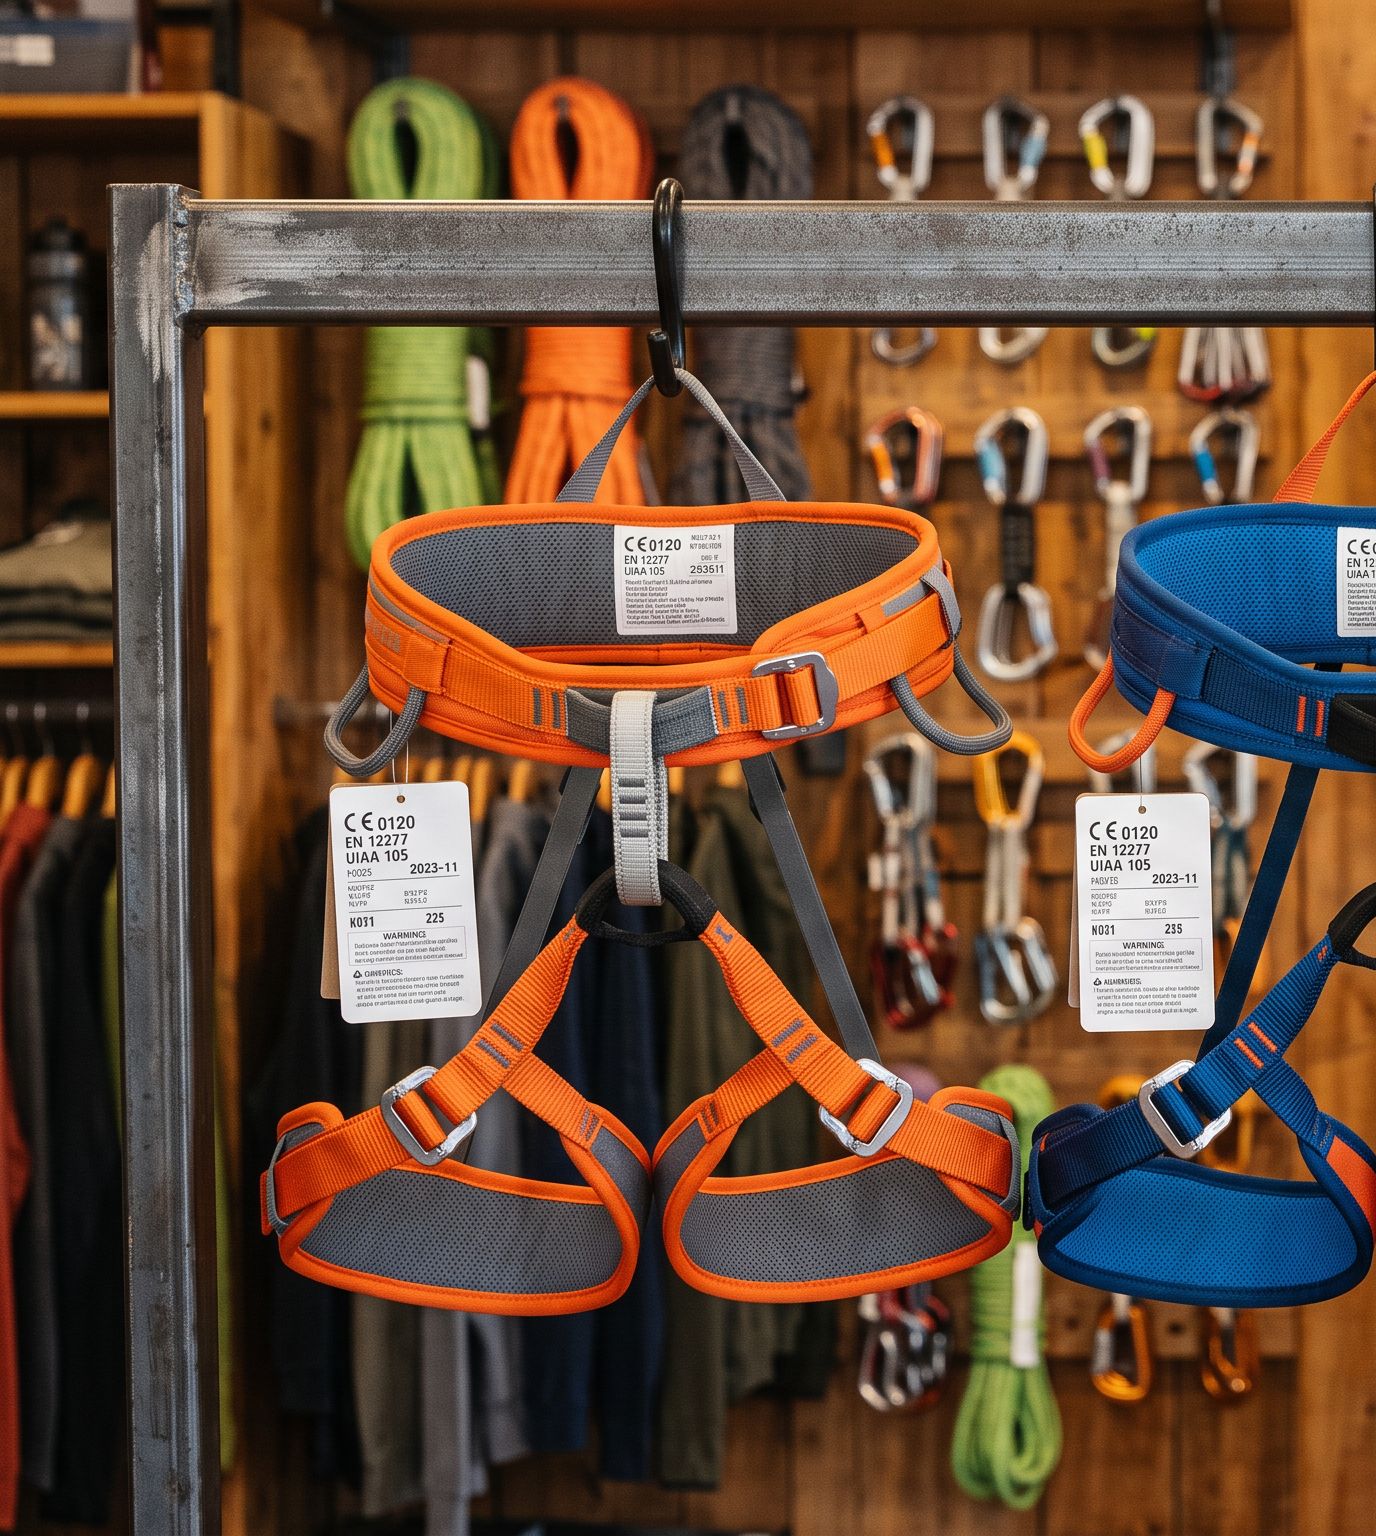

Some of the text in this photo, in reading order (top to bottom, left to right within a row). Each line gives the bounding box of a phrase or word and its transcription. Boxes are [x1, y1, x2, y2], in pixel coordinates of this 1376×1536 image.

[649, 539, 681, 551] 0120
[625, 555, 669, 564] EN 12277
[1347, 558, 1360, 567] EN
[625, 567, 647, 575] UIAA
[1347, 570, 1369, 578] UIAA
[378, 815, 415, 831] 0120
[1122, 826, 1158, 840] 0120
[346, 834, 408, 848] EN 12277
[1091, 844, 1150, 856] EN 12277
[346, 849, 408, 864] UIAA 105
[410, 862, 457, 874] 2023-11
[1091, 859, 1150, 871] UIAA 105
[1152, 873, 1196, 884] 2023-11
[426, 913, 444, 923] 225
